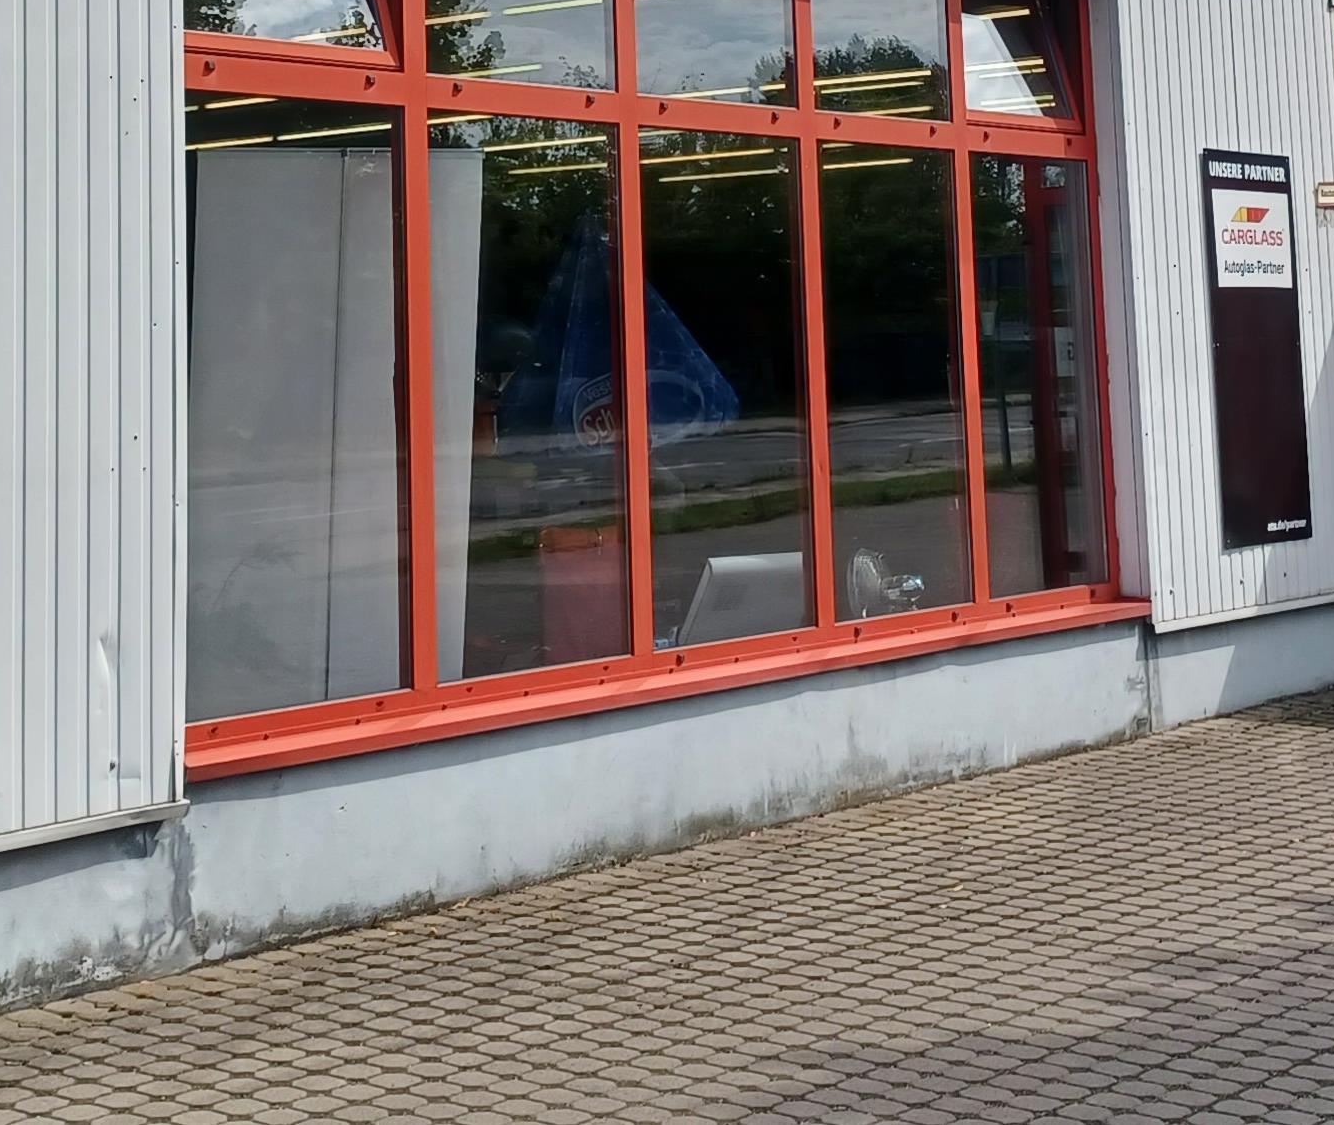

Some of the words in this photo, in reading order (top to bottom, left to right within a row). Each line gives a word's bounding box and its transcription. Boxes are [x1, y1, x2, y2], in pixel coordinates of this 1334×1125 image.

[1208, 160, 1243, 180] UNSERE
[1244, 164, 1286, 183] PARTNER
[1221, 228, 1284, 247] CARGLASS
[1224, 259, 1285, 277] Autoglas-Partner
